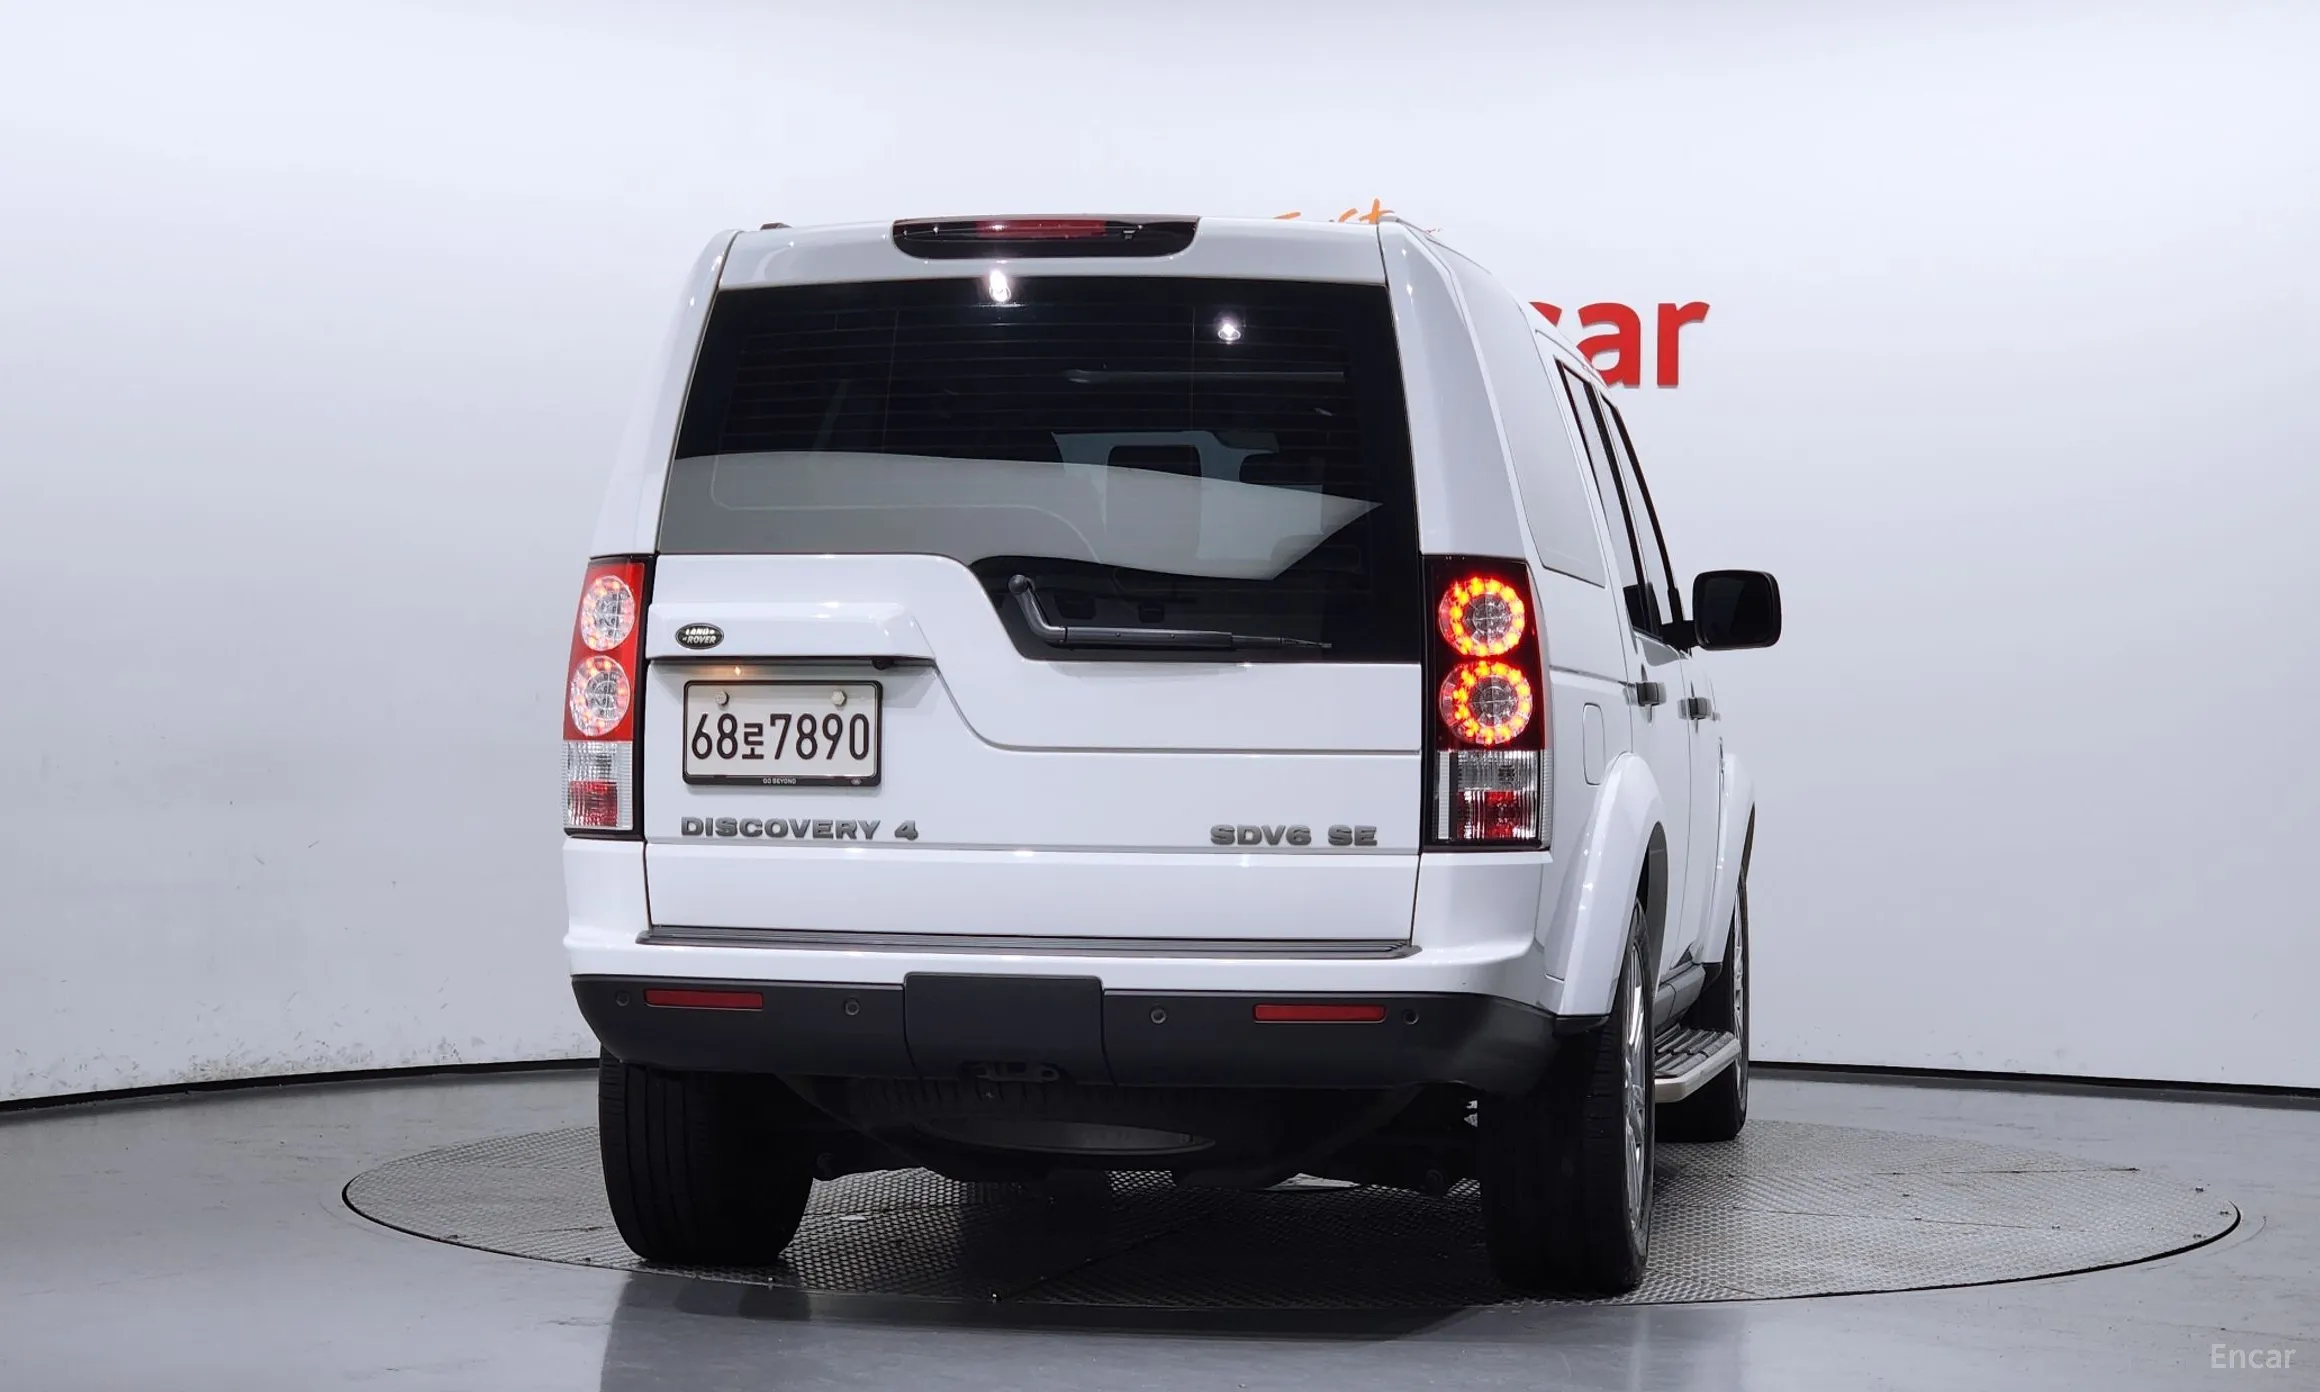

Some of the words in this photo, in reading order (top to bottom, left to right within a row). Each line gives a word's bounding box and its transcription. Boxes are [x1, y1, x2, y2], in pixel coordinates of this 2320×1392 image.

[1529, 301, 1710, 388] ar
[685, 628, 709, 636] LAND
[687, 635, 717, 644] ROVER
[691, 713, 870, 760] 68로7890
[681, 817, 881, 840] DISCOVERY
[894, 820, 919, 841] 4
[1210, 825, 1312, 846] SDV6
[1327, 825, 1378, 846] SE
